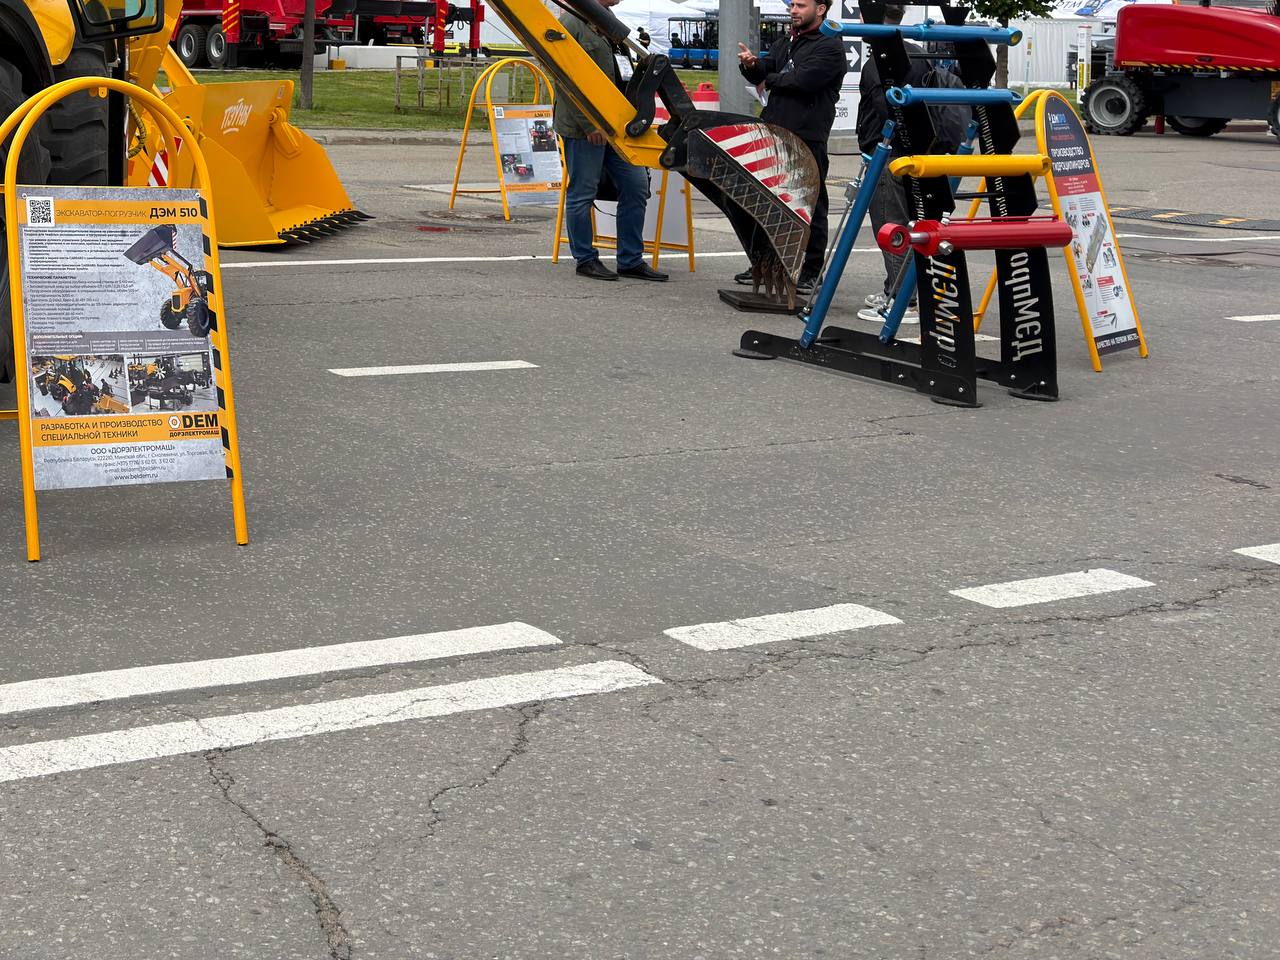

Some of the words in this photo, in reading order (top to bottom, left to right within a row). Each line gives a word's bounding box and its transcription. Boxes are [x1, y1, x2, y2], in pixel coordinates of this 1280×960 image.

[55, 209, 147, 218] ЭКСКАВАТОР-ПОГРУЗЧИК
[149, 208, 177, 219] ДЭМ
[180, 208, 198, 218] 510
[40, 422, 91, 431] РАЗРАБОТКА
[92, 421, 98, 429] И
[99, 419, 163, 429] ПРОИЗВОДСТВО
[182, 413, 219, 429] DEM
[41, 431, 101, 442] СПЕЦИАЛЬНОЙ
[103, 430, 138, 438] ТЕХНИКИ
[169, 429, 220, 438] ДОРЭЛЕКТРОМАШ
[90, 447, 107, 455] ООО
